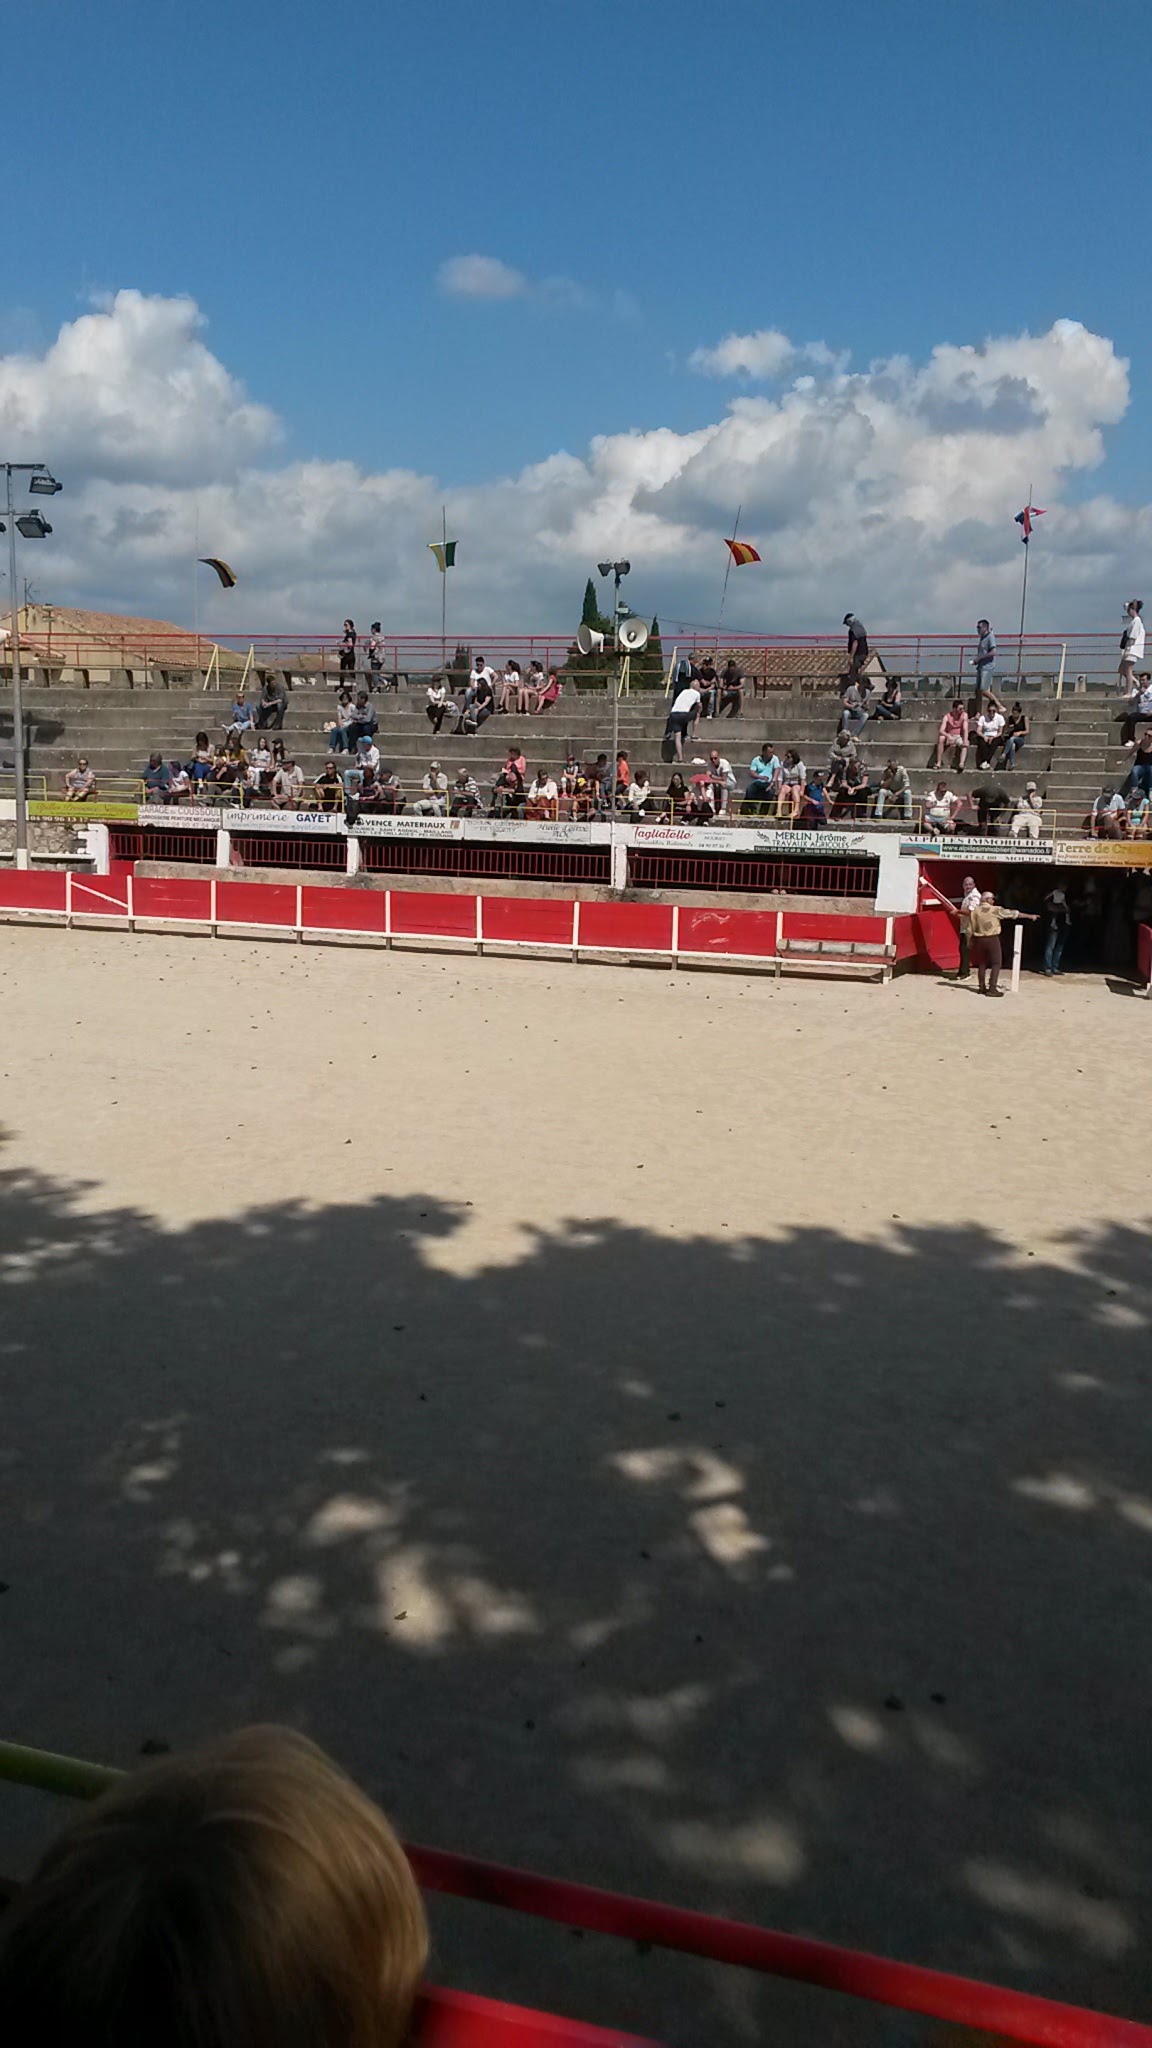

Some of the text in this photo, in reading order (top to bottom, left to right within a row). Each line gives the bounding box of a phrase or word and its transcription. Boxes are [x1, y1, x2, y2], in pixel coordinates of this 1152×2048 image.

[139, 805, 169, 814] GARAGE
[178, 806, 221, 816] COUSSOUL
[296, 813, 331, 823] GAYET
[397, 821, 446, 829] MATERIAUX
[632, 826, 693, 840] Tagliatelle
[775, 831, 847, 842] MERLIN Jérôme
[772, 839, 849, 849] TRAVAUX AGRICOLES
[906, 835, 1047, 846] ALPILLES IMMOBILIER
[1057, 842, 1092, 853] Terre
[1094, 843, 1110, 854] de
